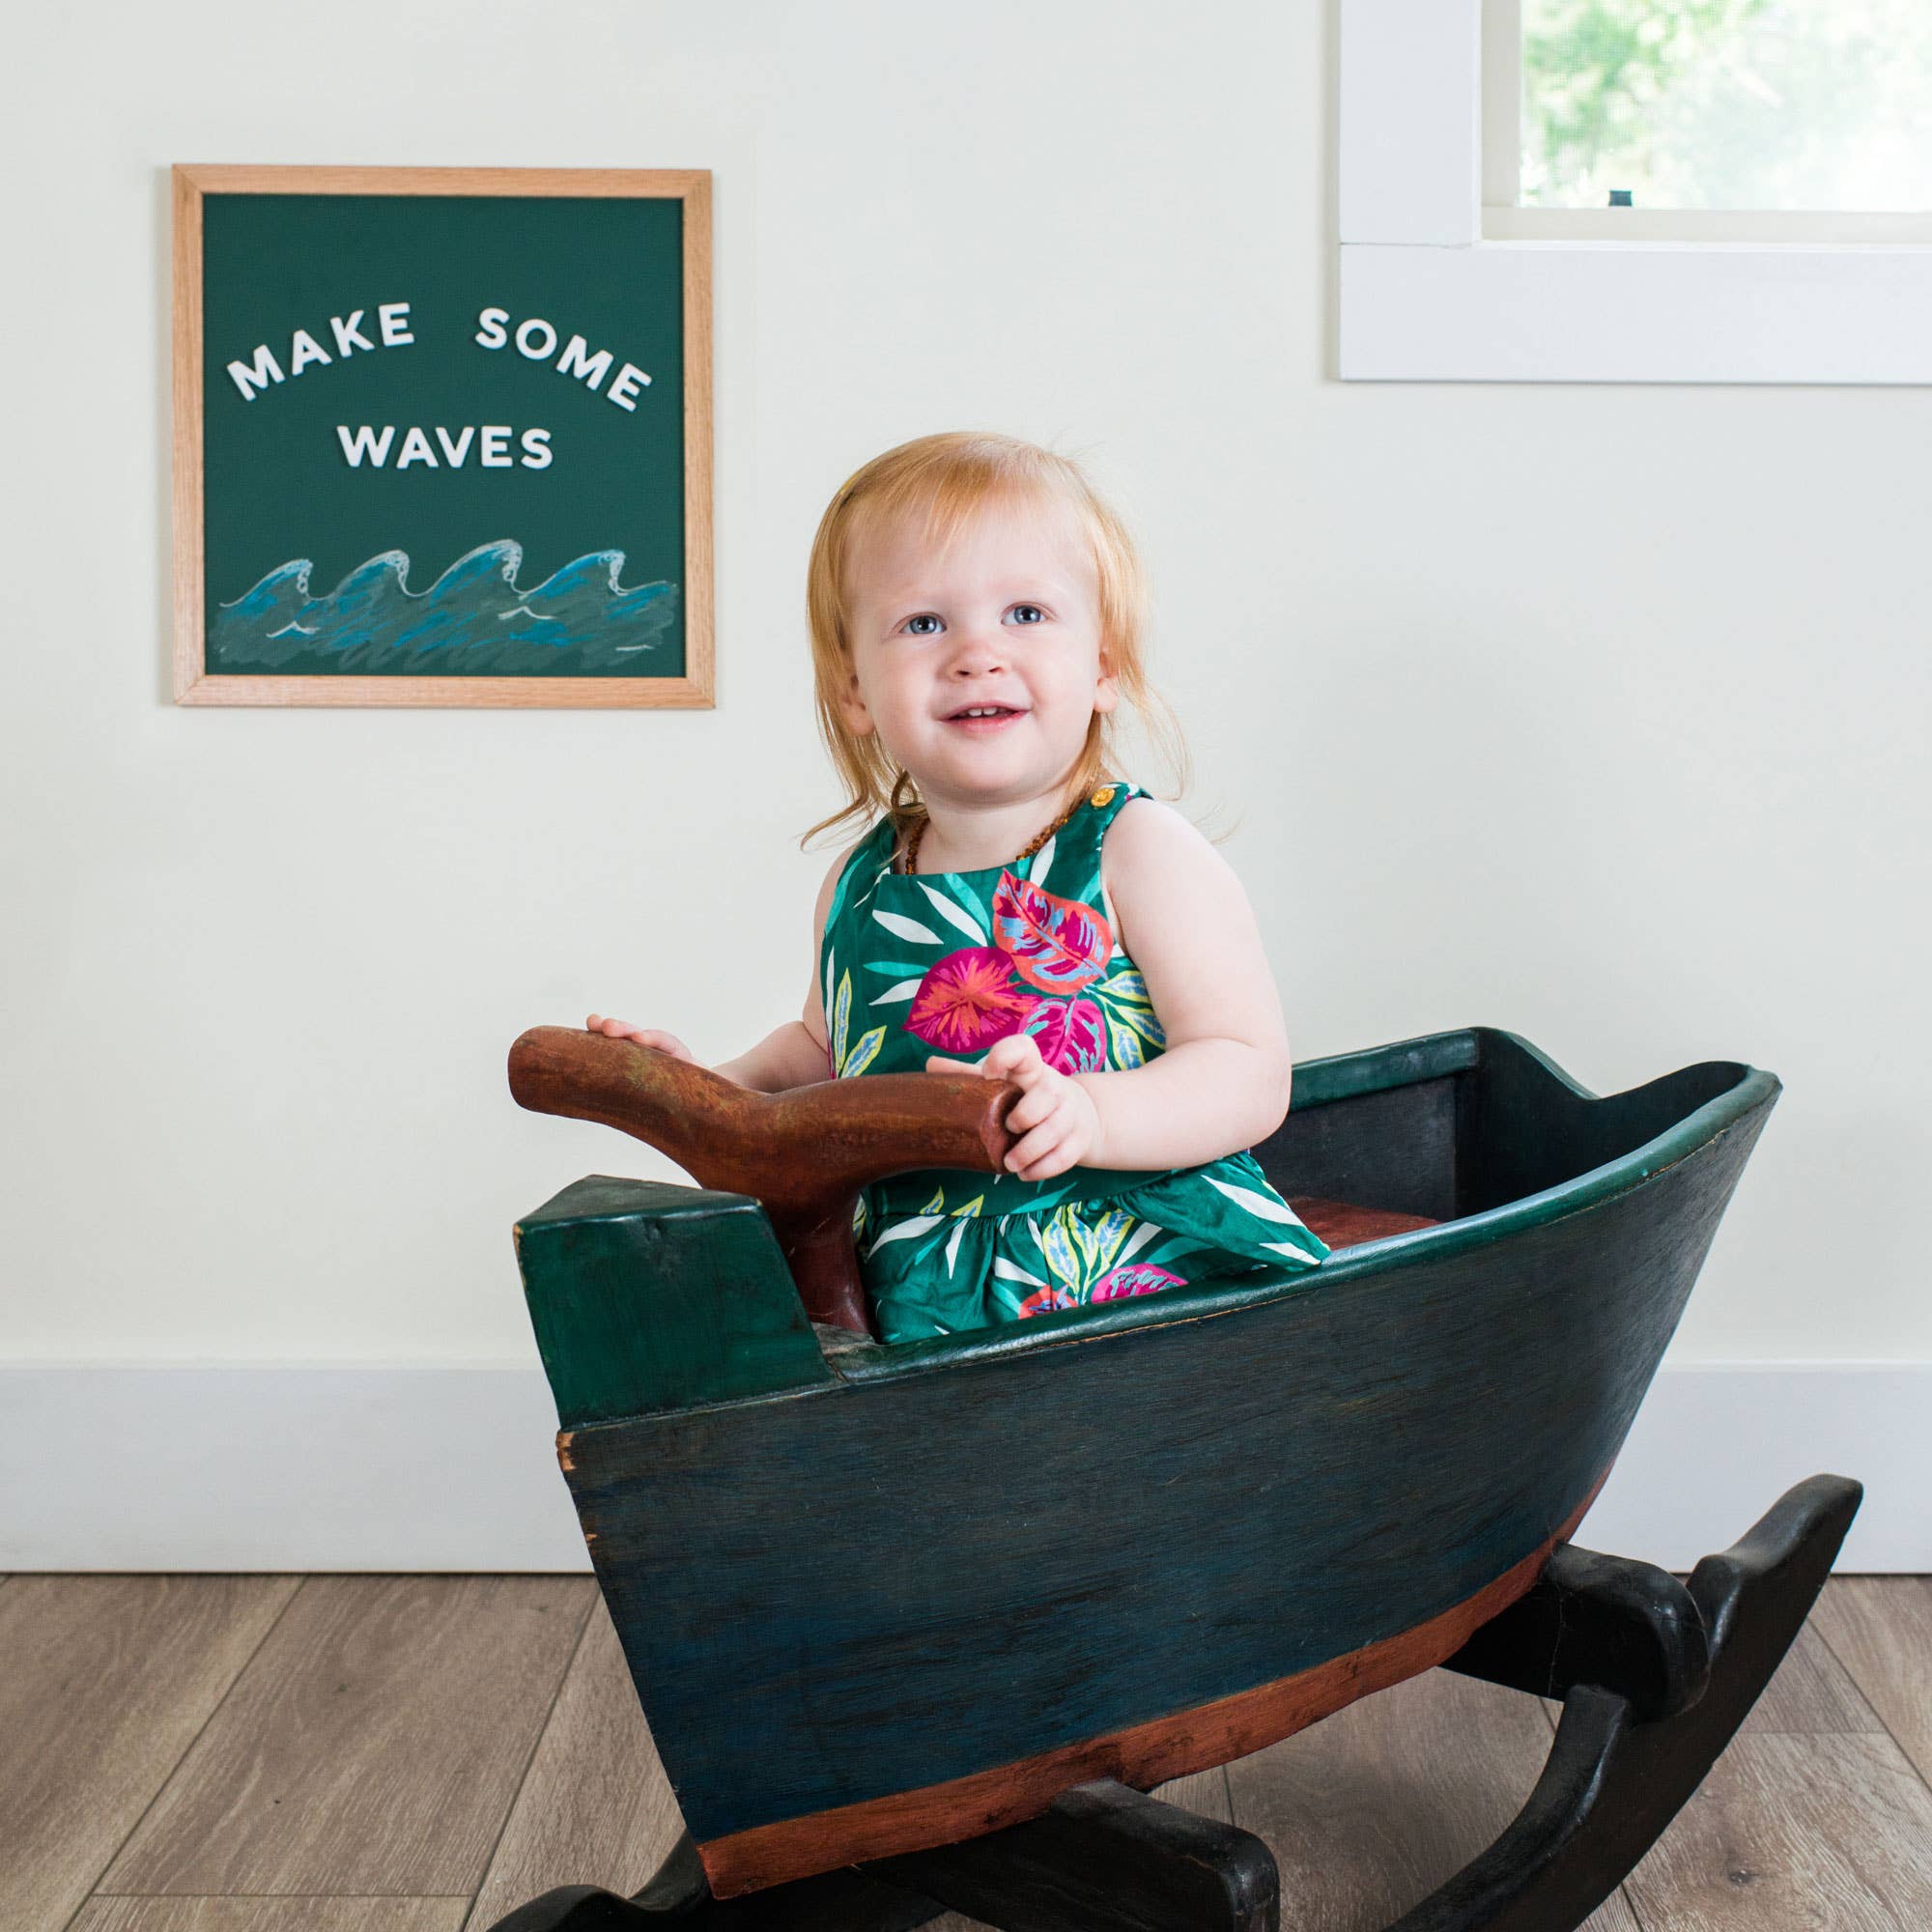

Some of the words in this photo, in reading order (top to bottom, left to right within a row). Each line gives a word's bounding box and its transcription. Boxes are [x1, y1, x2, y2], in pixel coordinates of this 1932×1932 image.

[227, 302, 414, 401] MAKE
[475, 307, 652, 412] SOME
[336, 425, 554, 469] WAVES
